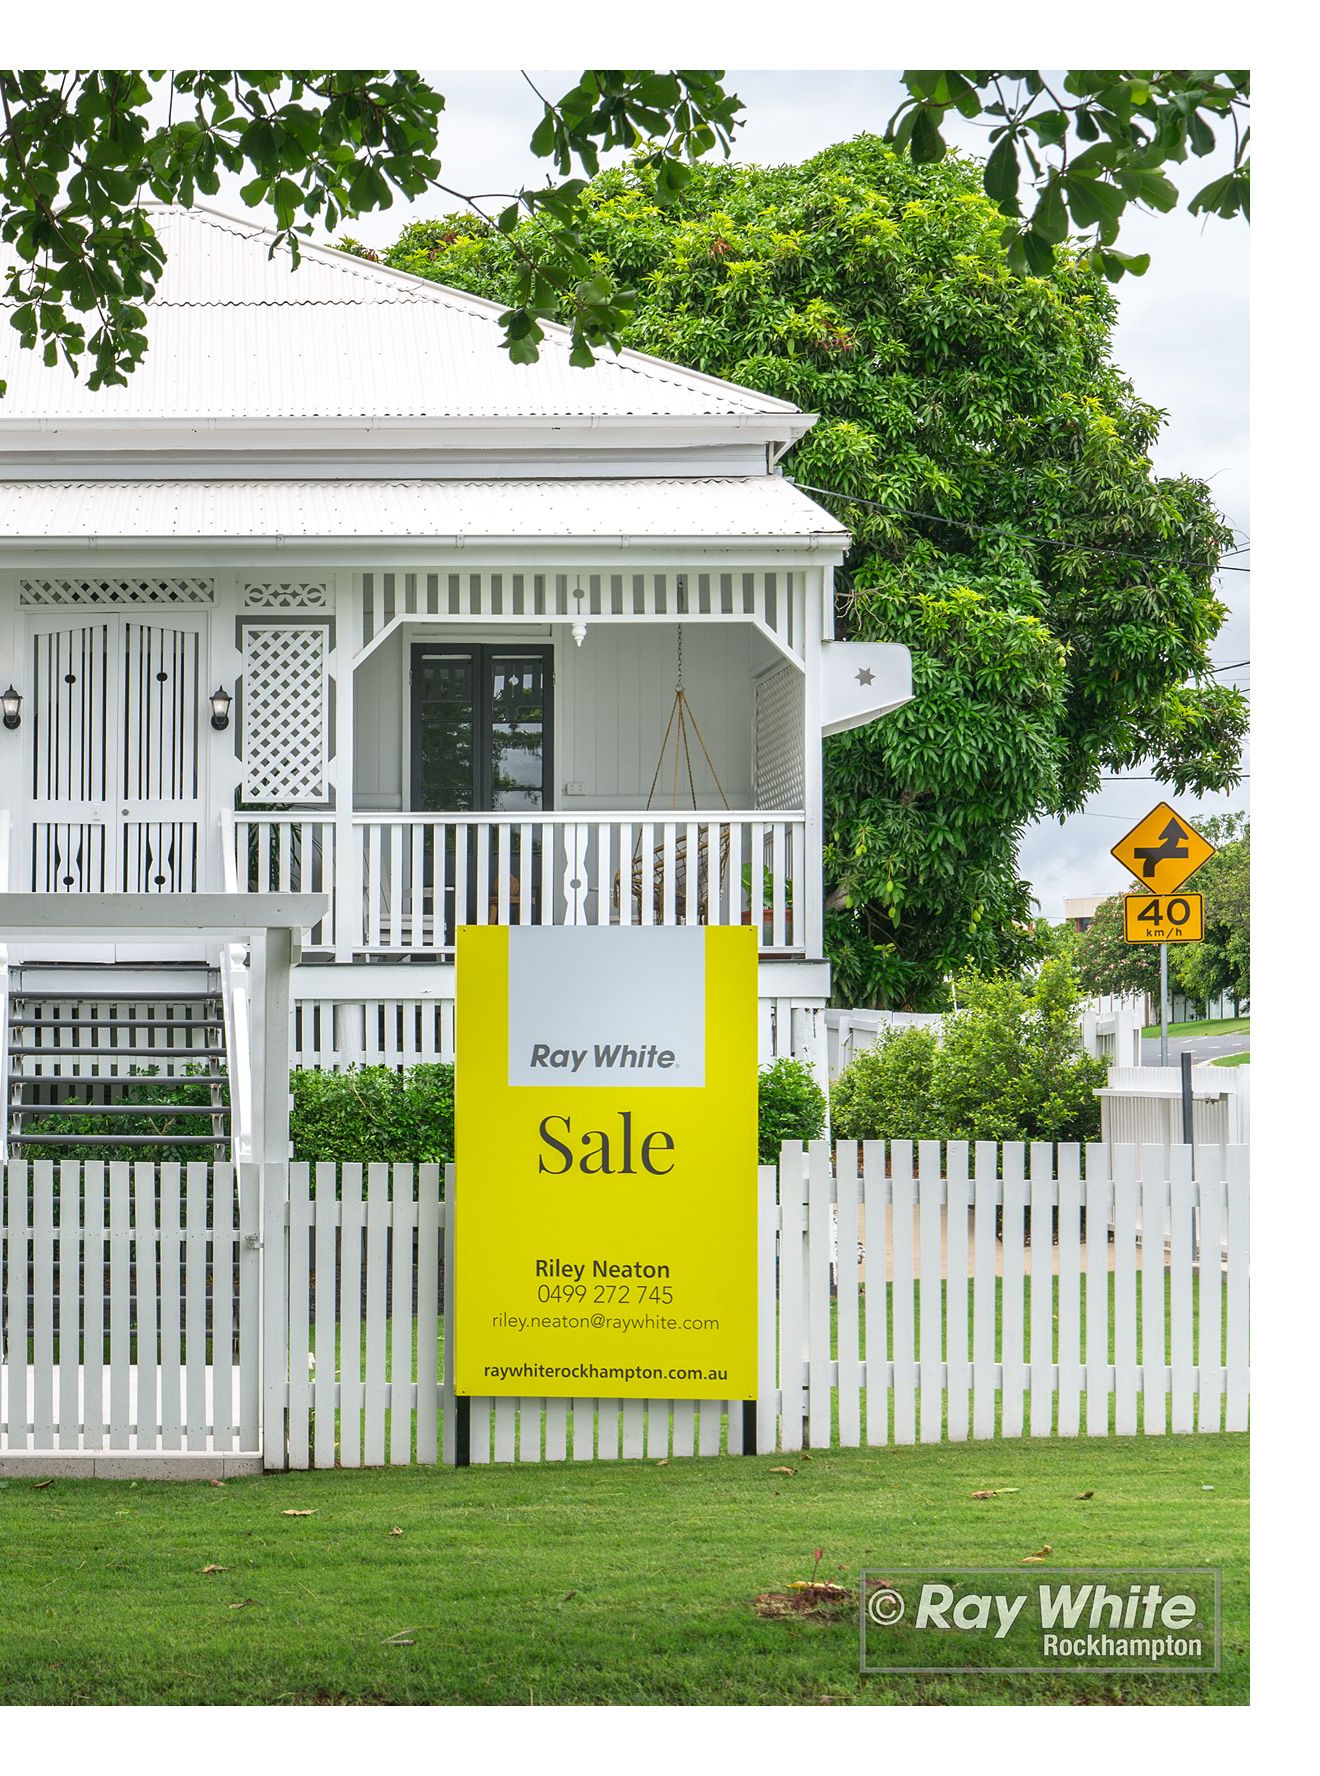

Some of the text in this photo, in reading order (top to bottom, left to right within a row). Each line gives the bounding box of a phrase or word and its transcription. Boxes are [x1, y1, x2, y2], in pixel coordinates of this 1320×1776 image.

[1137, 898, 1191, 926] 40
[1146, 928, 1182, 939] km/h
[530, 1044, 676, 1073] Ray White
[538, 1111, 675, 1175] Sale
[535, 1259, 670, 1282] Riley Neaton
[537, 1284, 673, 1305] 0499 272 745
[492, 1312, 720, 1333] riley.neaton@raywhite.com
[483, 1363, 728, 1382] raywhiterockhampton.com.au
